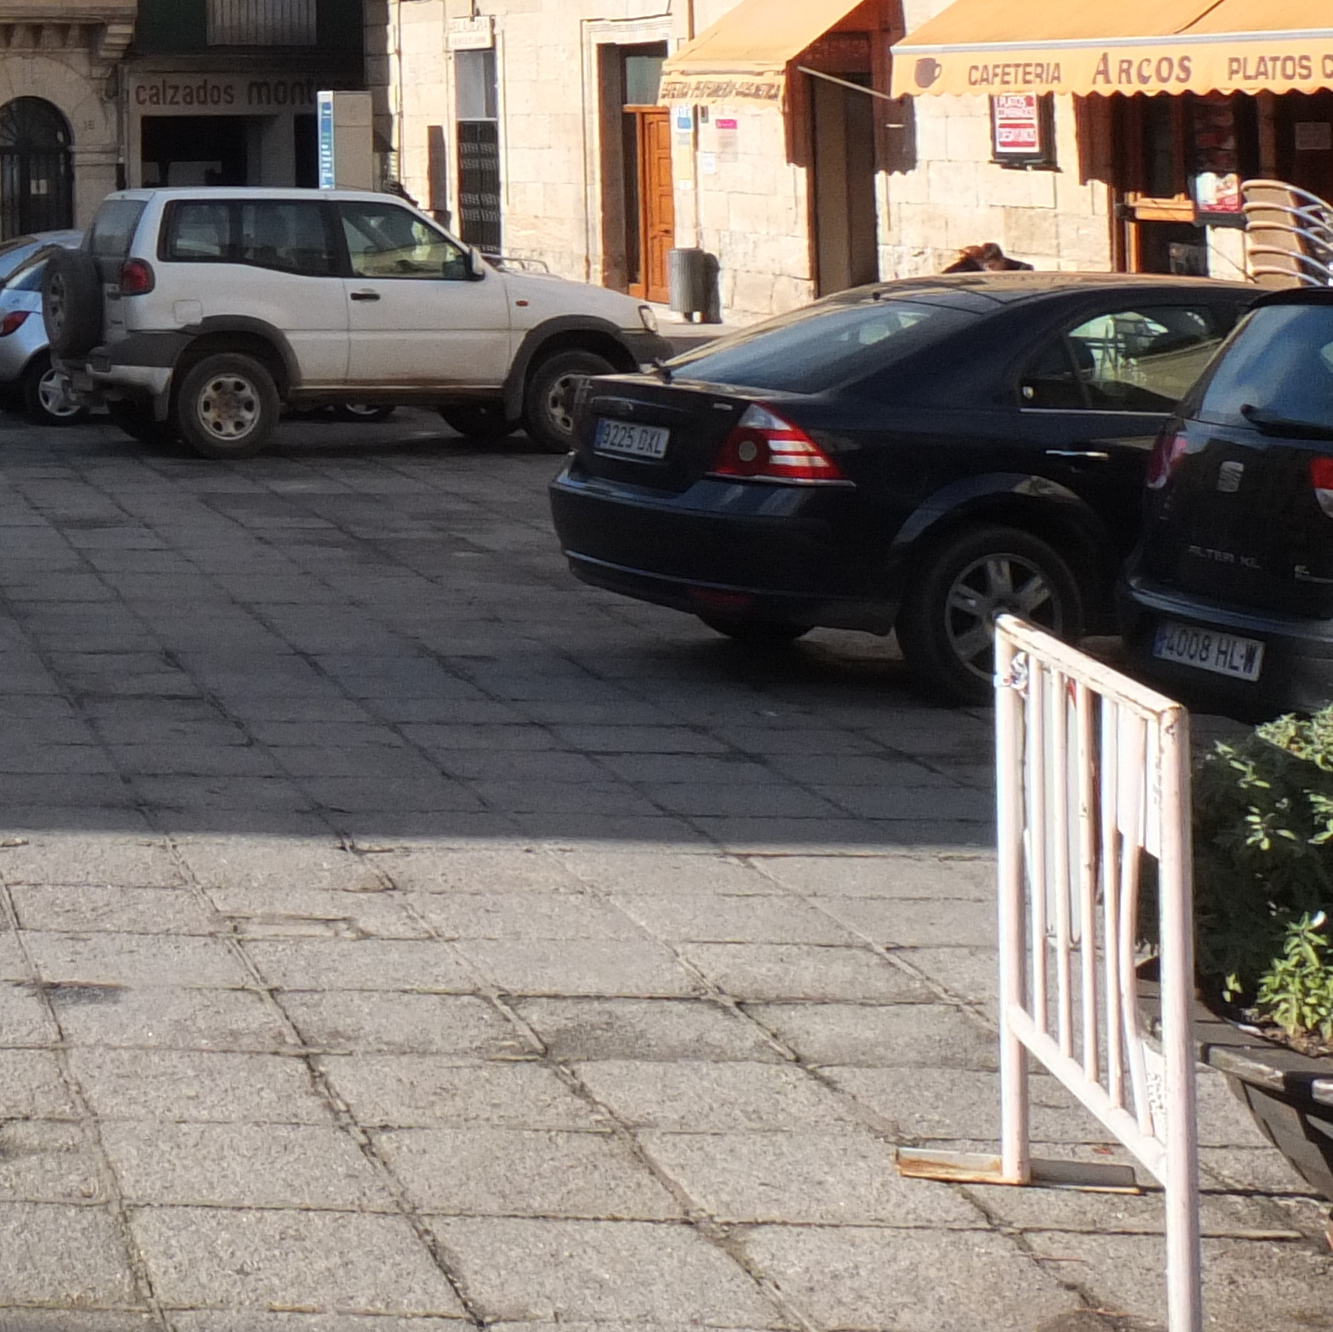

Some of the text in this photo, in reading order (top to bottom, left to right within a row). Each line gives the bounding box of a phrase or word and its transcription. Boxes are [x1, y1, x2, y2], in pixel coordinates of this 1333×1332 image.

[968, 61, 1063, 87] CAFETERIA
[1227, 54, 1313, 82] PLATOS
[135, 78, 234, 106] calzados
[602, 424, 663, 455] 9225 DXL
[1166, 628, 1211, 662] 4008
